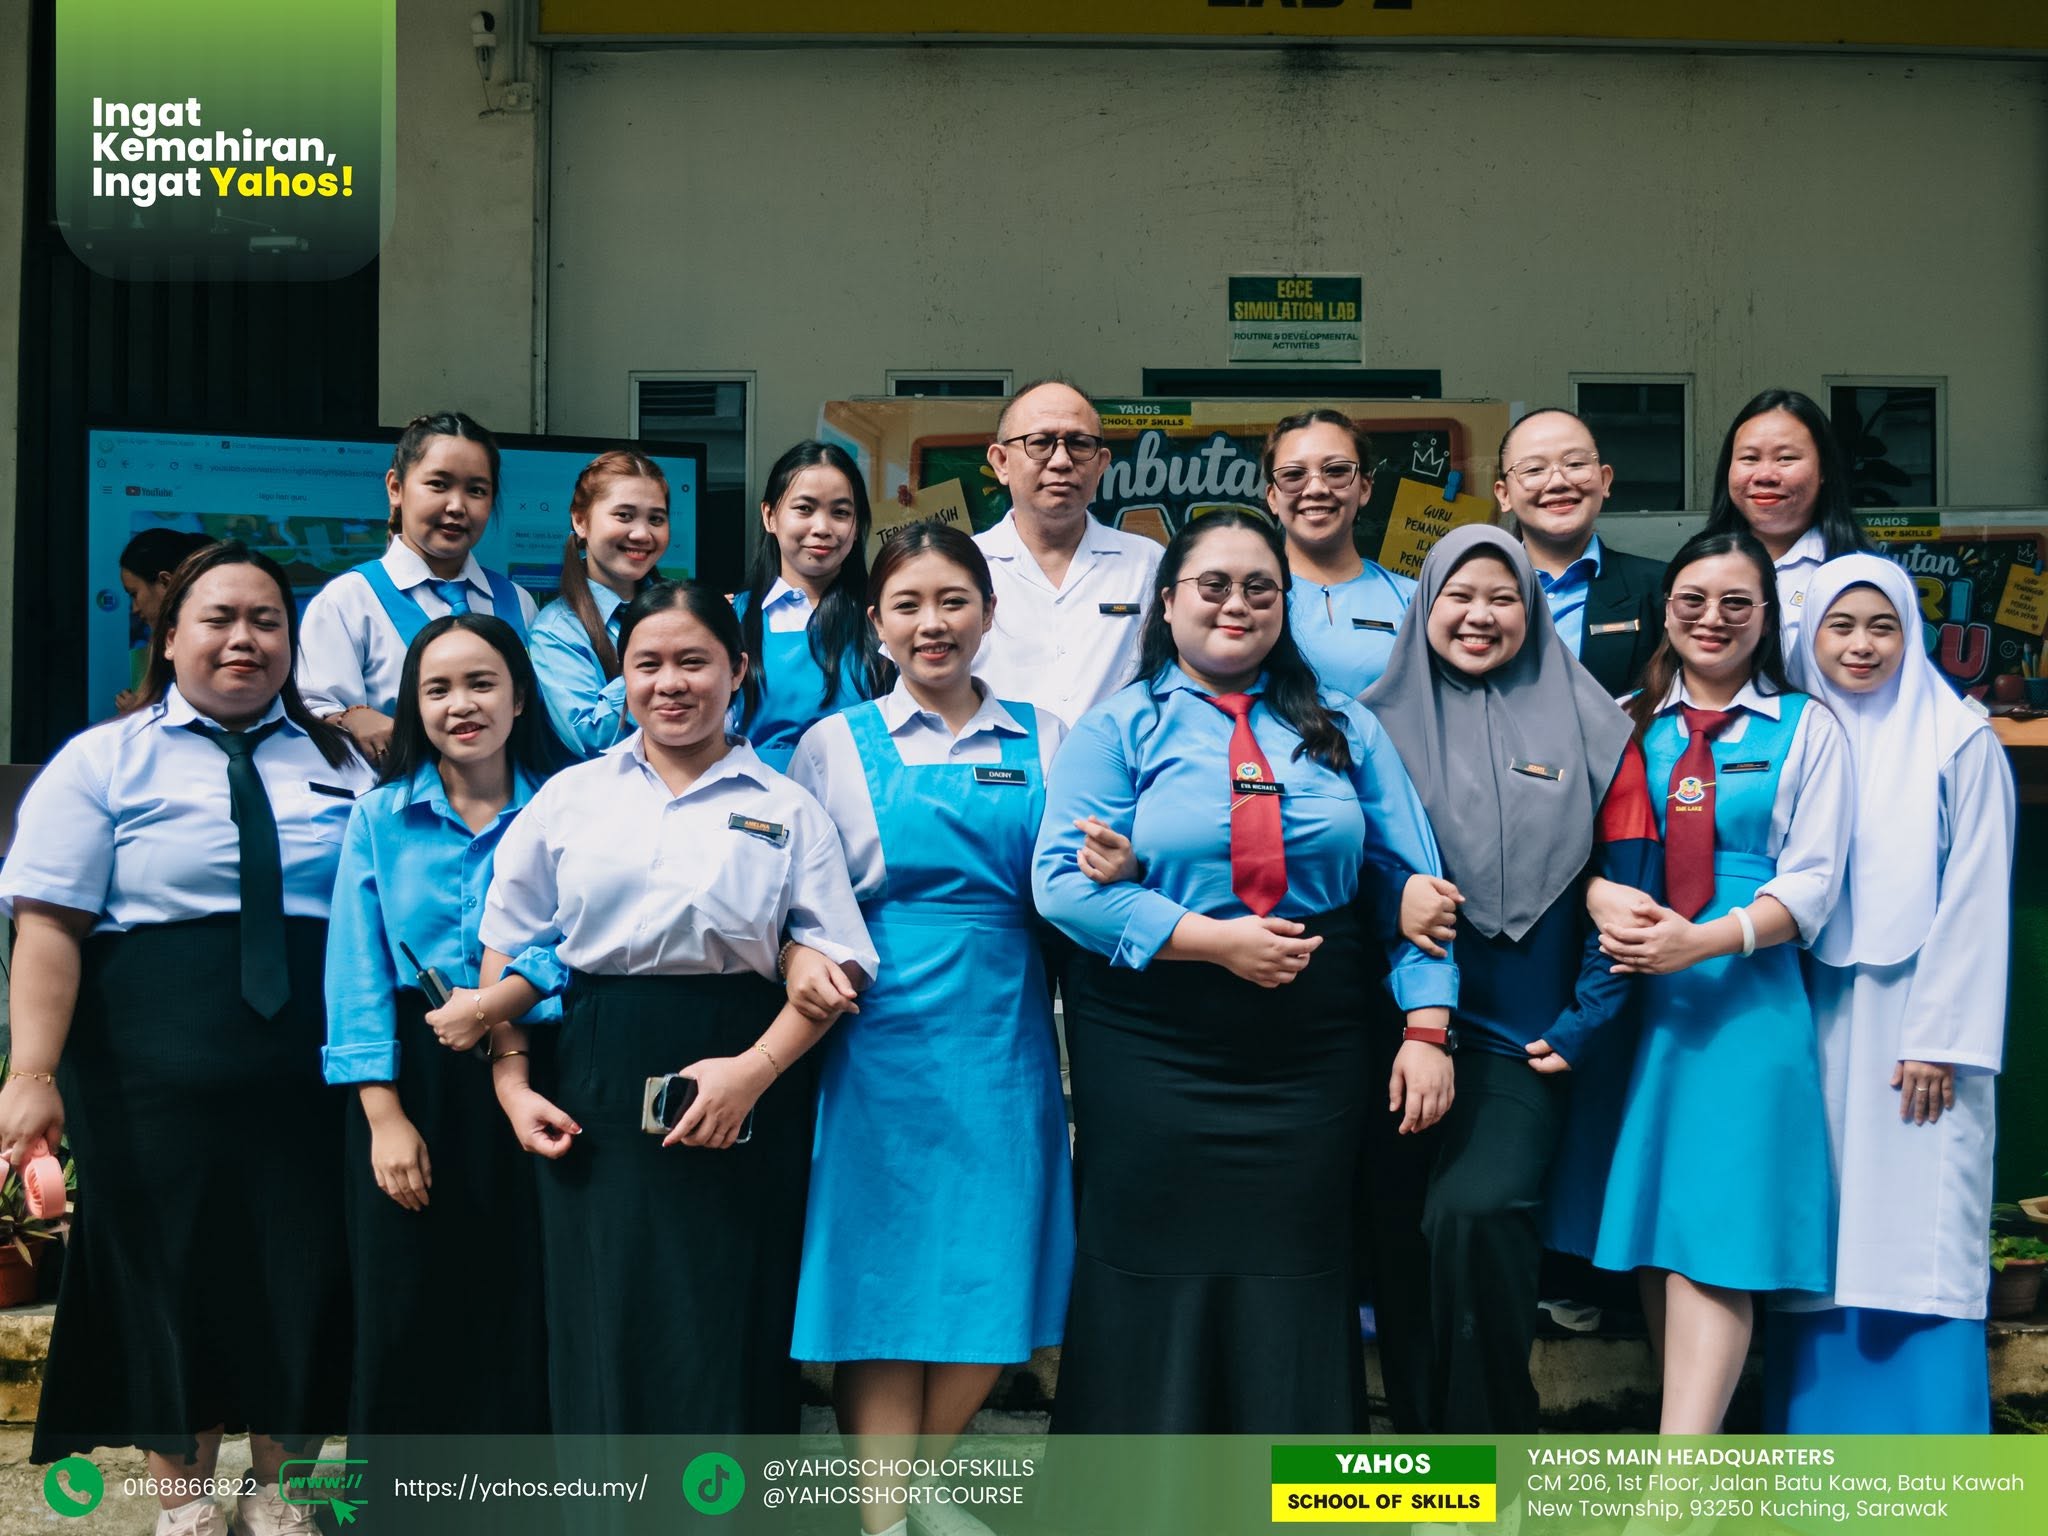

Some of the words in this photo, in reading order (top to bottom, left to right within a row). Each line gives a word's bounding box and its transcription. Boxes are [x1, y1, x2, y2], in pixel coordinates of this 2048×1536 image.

[1277, 280, 1313, 298] ECCE
[1234, 302, 1323, 320] SIMULATION
[1328, 302, 1356, 320] LAB
[1120, 405, 1161, 414] YAHOS
[1101, 418, 1134, 426] CHOOL
[1151, 418, 1184, 426] SKILLS
[141, 486, 173, 498] YouTube
[1424, 504, 1453, 522] GURU
[1404, 516, 1450, 537] PEMANG
[1866, 517, 1909, 526] YAHOS
